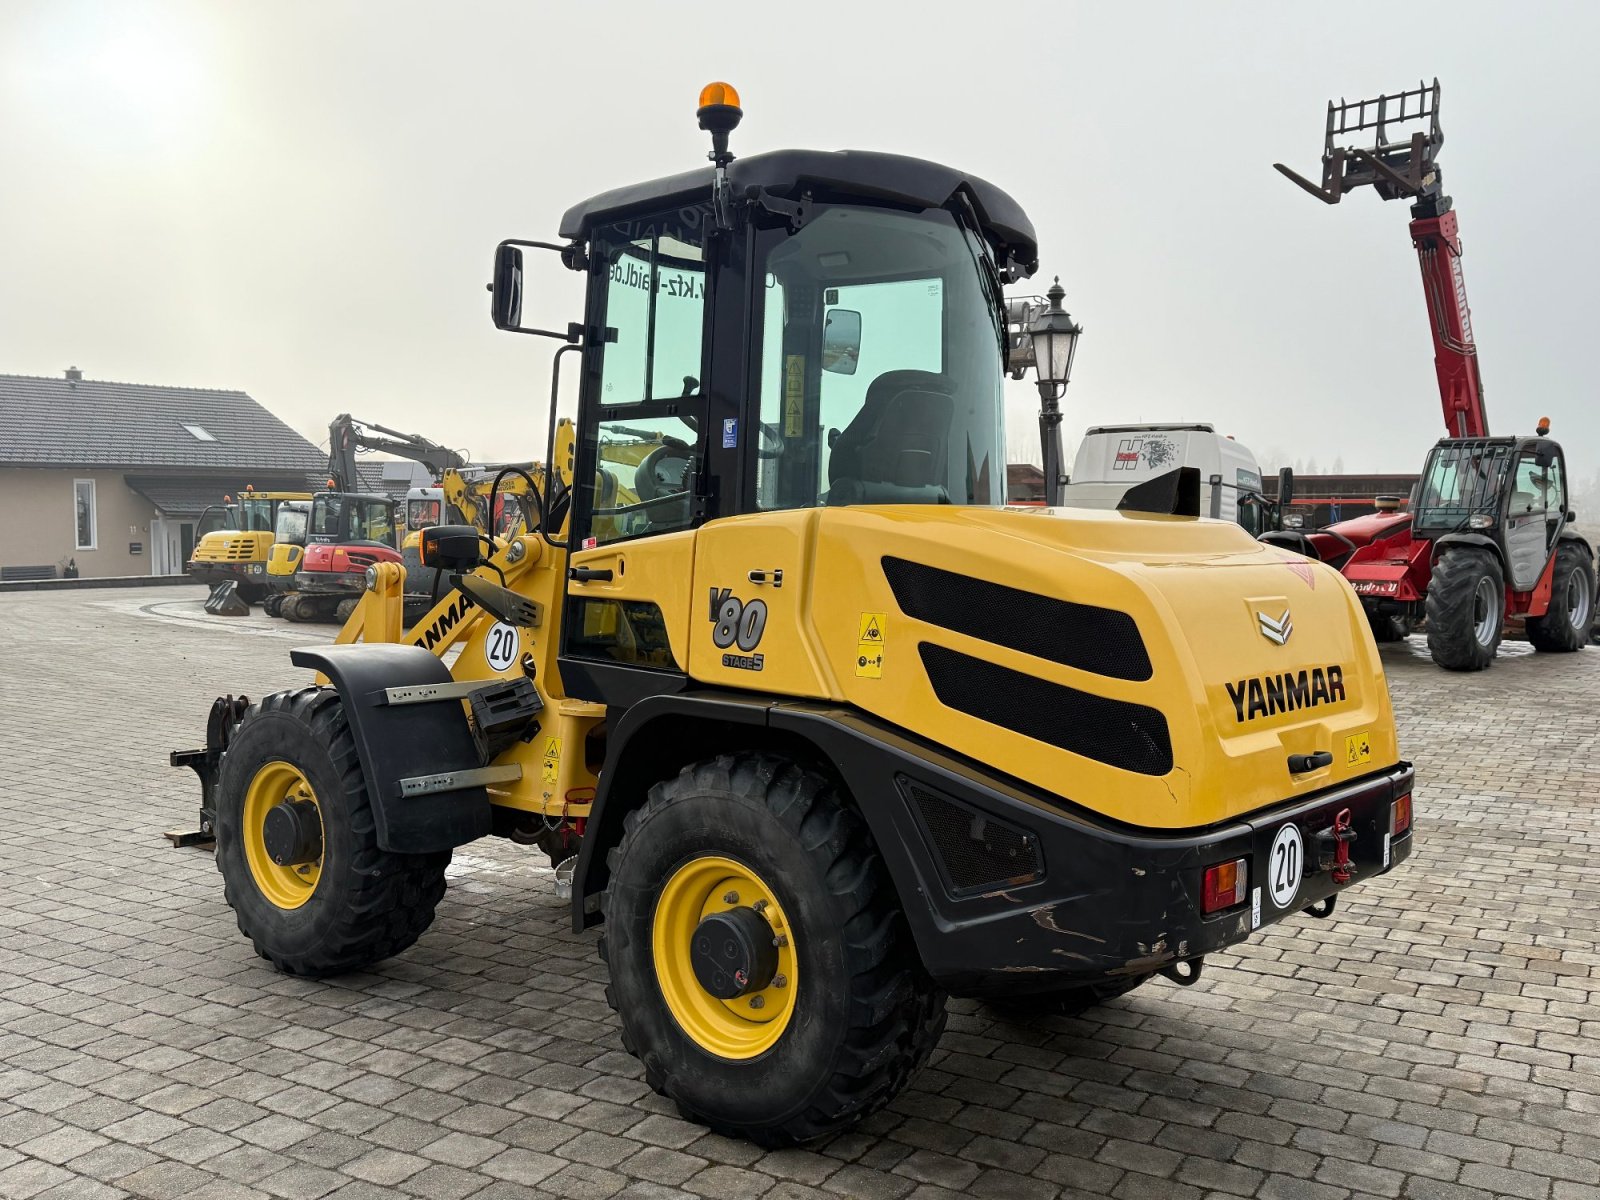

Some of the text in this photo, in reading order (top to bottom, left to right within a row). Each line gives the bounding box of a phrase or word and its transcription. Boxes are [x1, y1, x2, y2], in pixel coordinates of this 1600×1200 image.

[1452, 255, 1472, 343] MANITOU
[490, 628, 514, 661] 20
[1225, 665, 1346, 723] YANMAR
[1275, 840, 1297, 894] 20
